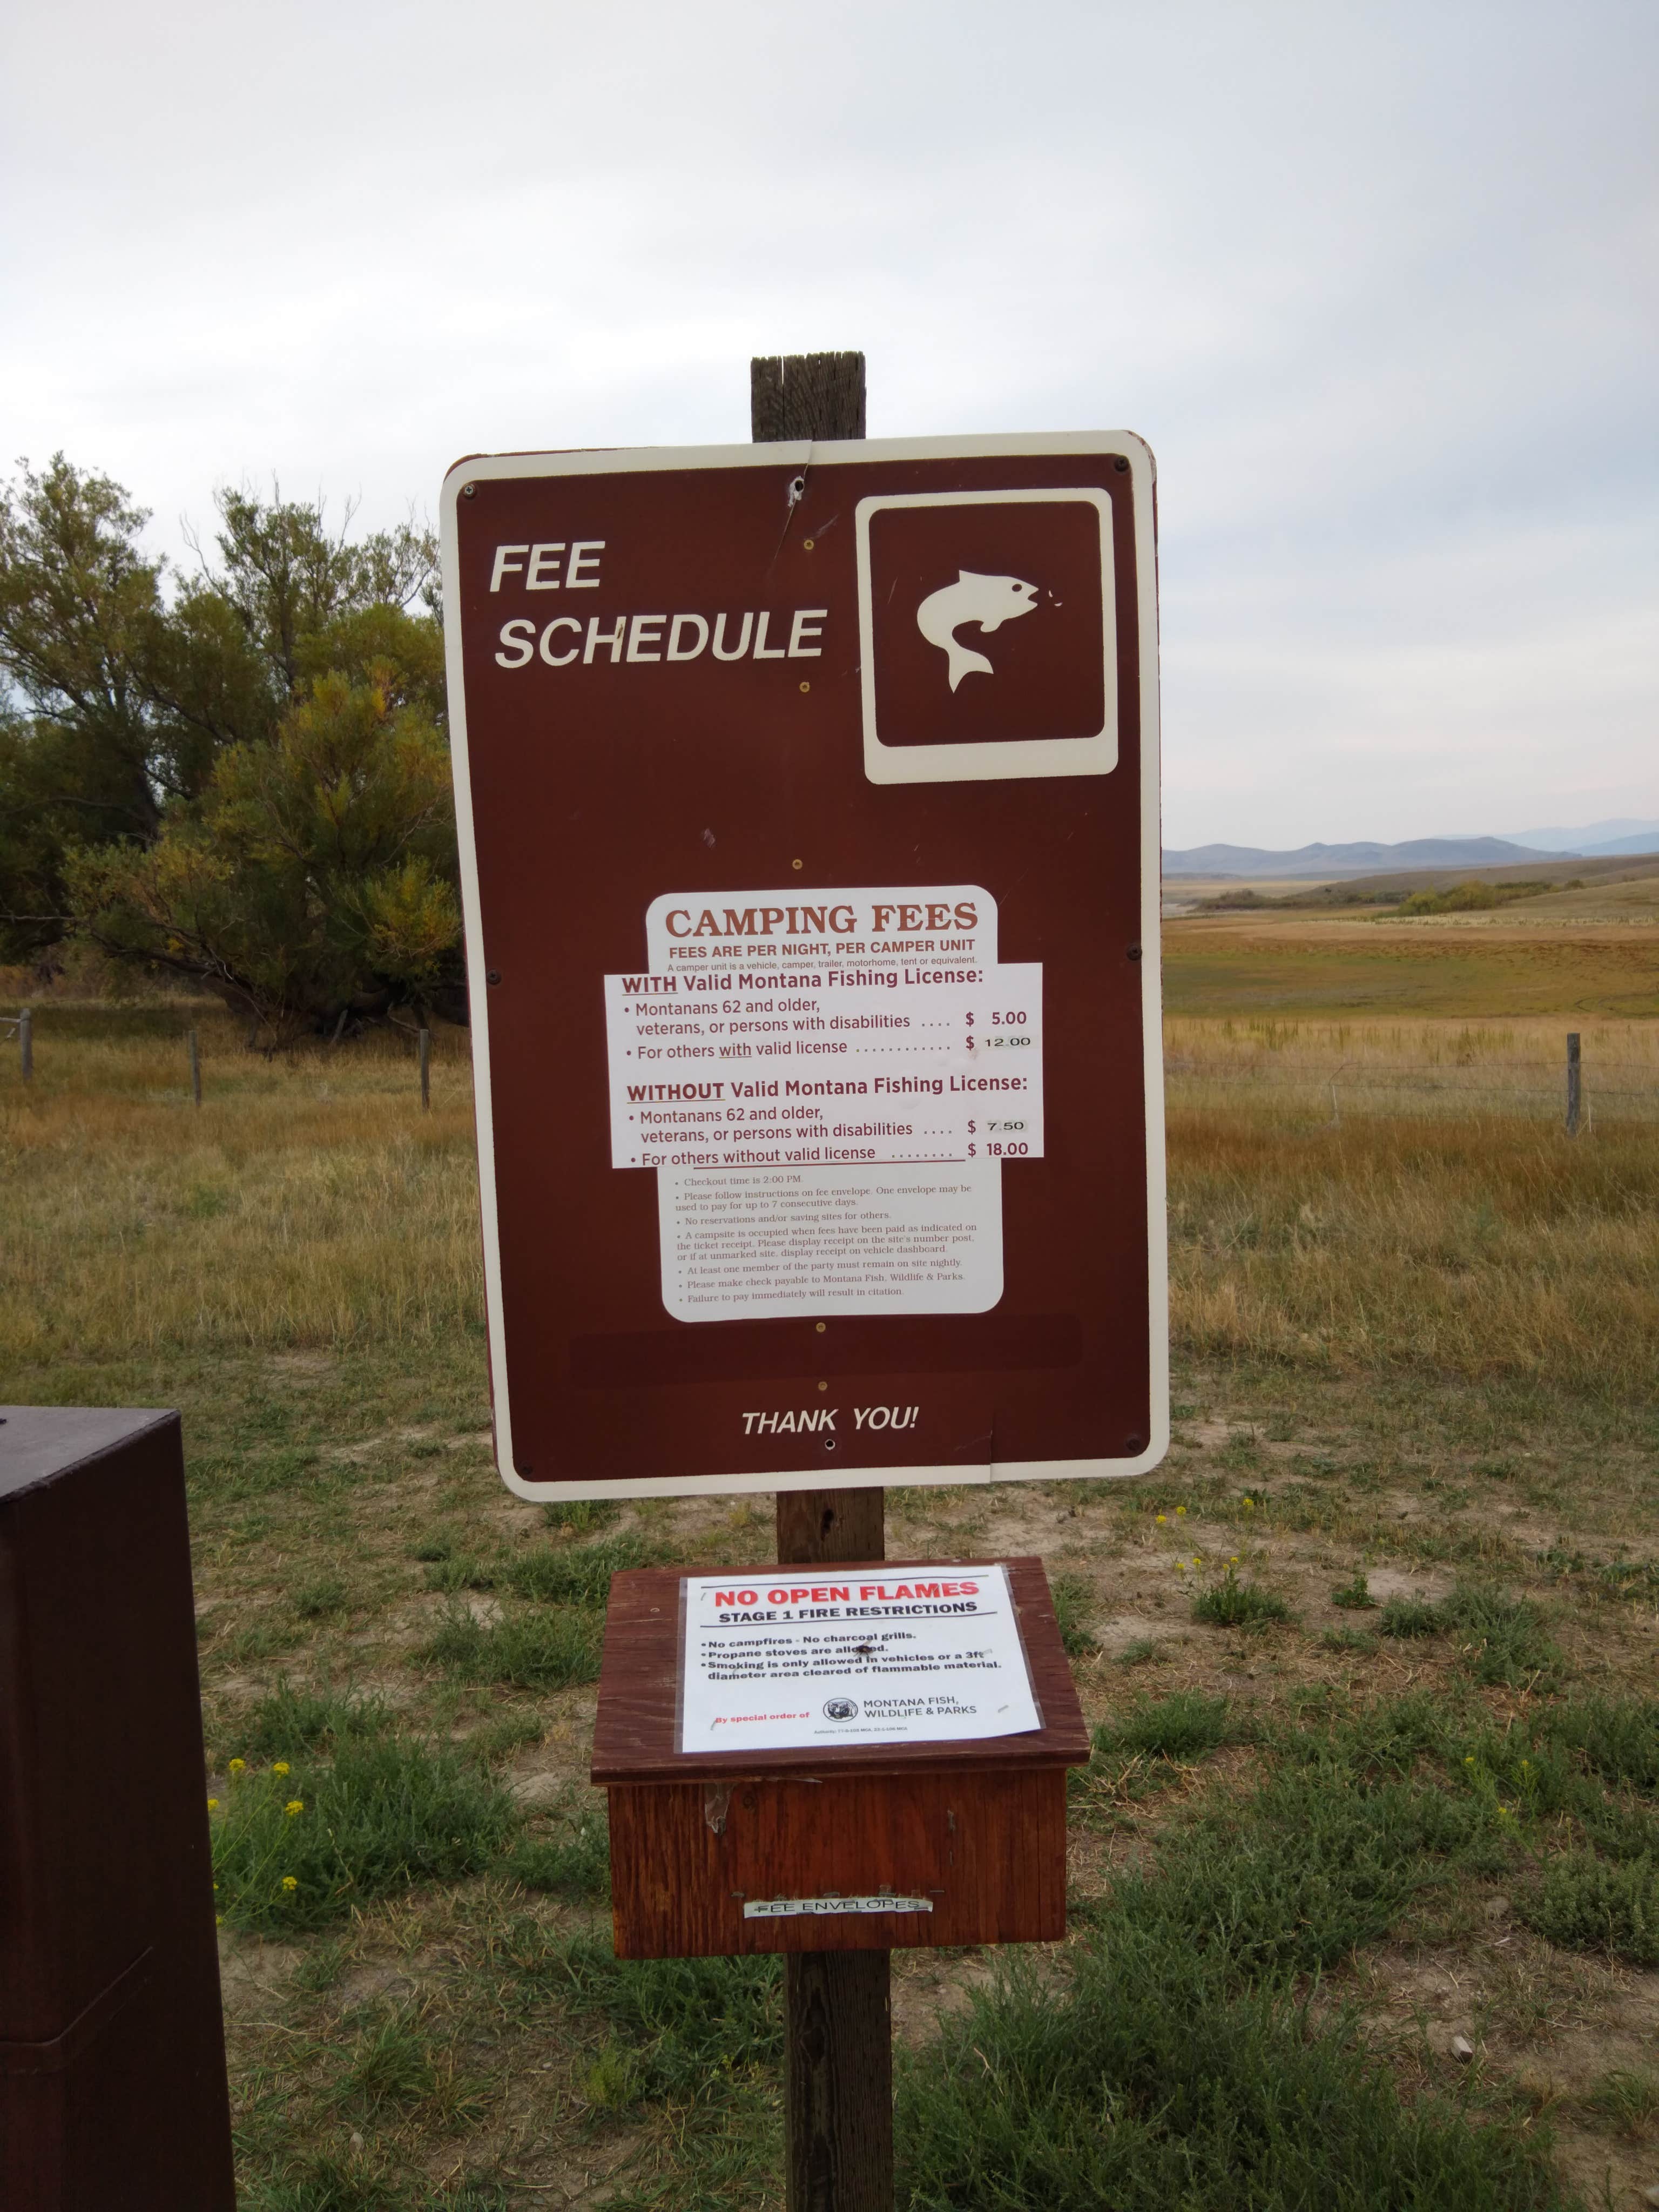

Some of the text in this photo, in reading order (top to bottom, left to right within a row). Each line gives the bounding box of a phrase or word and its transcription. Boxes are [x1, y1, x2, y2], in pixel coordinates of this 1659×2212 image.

[490, 541, 606, 592] FEE
[495, 609, 828, 669] SCHEDULE
[665, 902, 977, 938] CAMPING FEES
[670, 939, 975, 959] FEES ARE PER NIGHT, PER CAMPER UNIT
[747, 962, 779, 970] vehicle,
[818, 960, 844, 968] trailer,
[622, 968, 982, 996] WITH Valid Montana Fishing License:
[636, 998, 819, 1016] Montanans 62 and older,
[636, 1011, 1027, 1035] veterans, or persons with disabilities $ 5.00
[638, 1035, 1030, 1059] For others with valid license $ 12.00
[627, 1075, 1027, 1104] WITHOUT Valid Montana Fishing License:
[641, 1106, 822, 1124] Montanans 62 and older,
[641, 1120, 1023, 1143] veterans, or persons with disabilities $ 7.50
[643, 1143, 1028, 1165] For others without valid license $ 18.00
[684, 1178, 726, 1186] Checkout
[745, 1190, 799, 1198] instructions
[897, 1185, 936, 1195] envelope
[780, 1199, 832, 1208] consecutive
[791, 1214, 819, 1223] saving
[742, 1406, 919, 1434] THANK YOU!
[716, 1582, 979, 1607] NO OPEN FLAMES
[719, 1602, 977, 1623] STAGE 1 FIRE RESTRICTIONS
[729, 1638, 792, 1647] campfires
[824, 1633, 878, 1644] charcoal
[881, 1632, 916, 1641] grills.
[708, 1662, 764, 1670] Smoking
[813, 1657, 862, 1665] allowed
[709, 1651, 761, 1660] Propane
[708, 1671, 766, 1680] diameter
[803, 1668, 851, 1676] cleared
[872, 1664, 940, 1673] flammable
[944, 1661, 1001, 1669] material.
[864, 1696, 959, 1708] MONTANA FISH,
[731, 1714, 766, 1723] special
[865, 1708, 922, 1717] WILDLIFE
[938, 1706, 976, 1714] PARKS
[757, 1899, 920, 1913] FEE ENVELOPES
